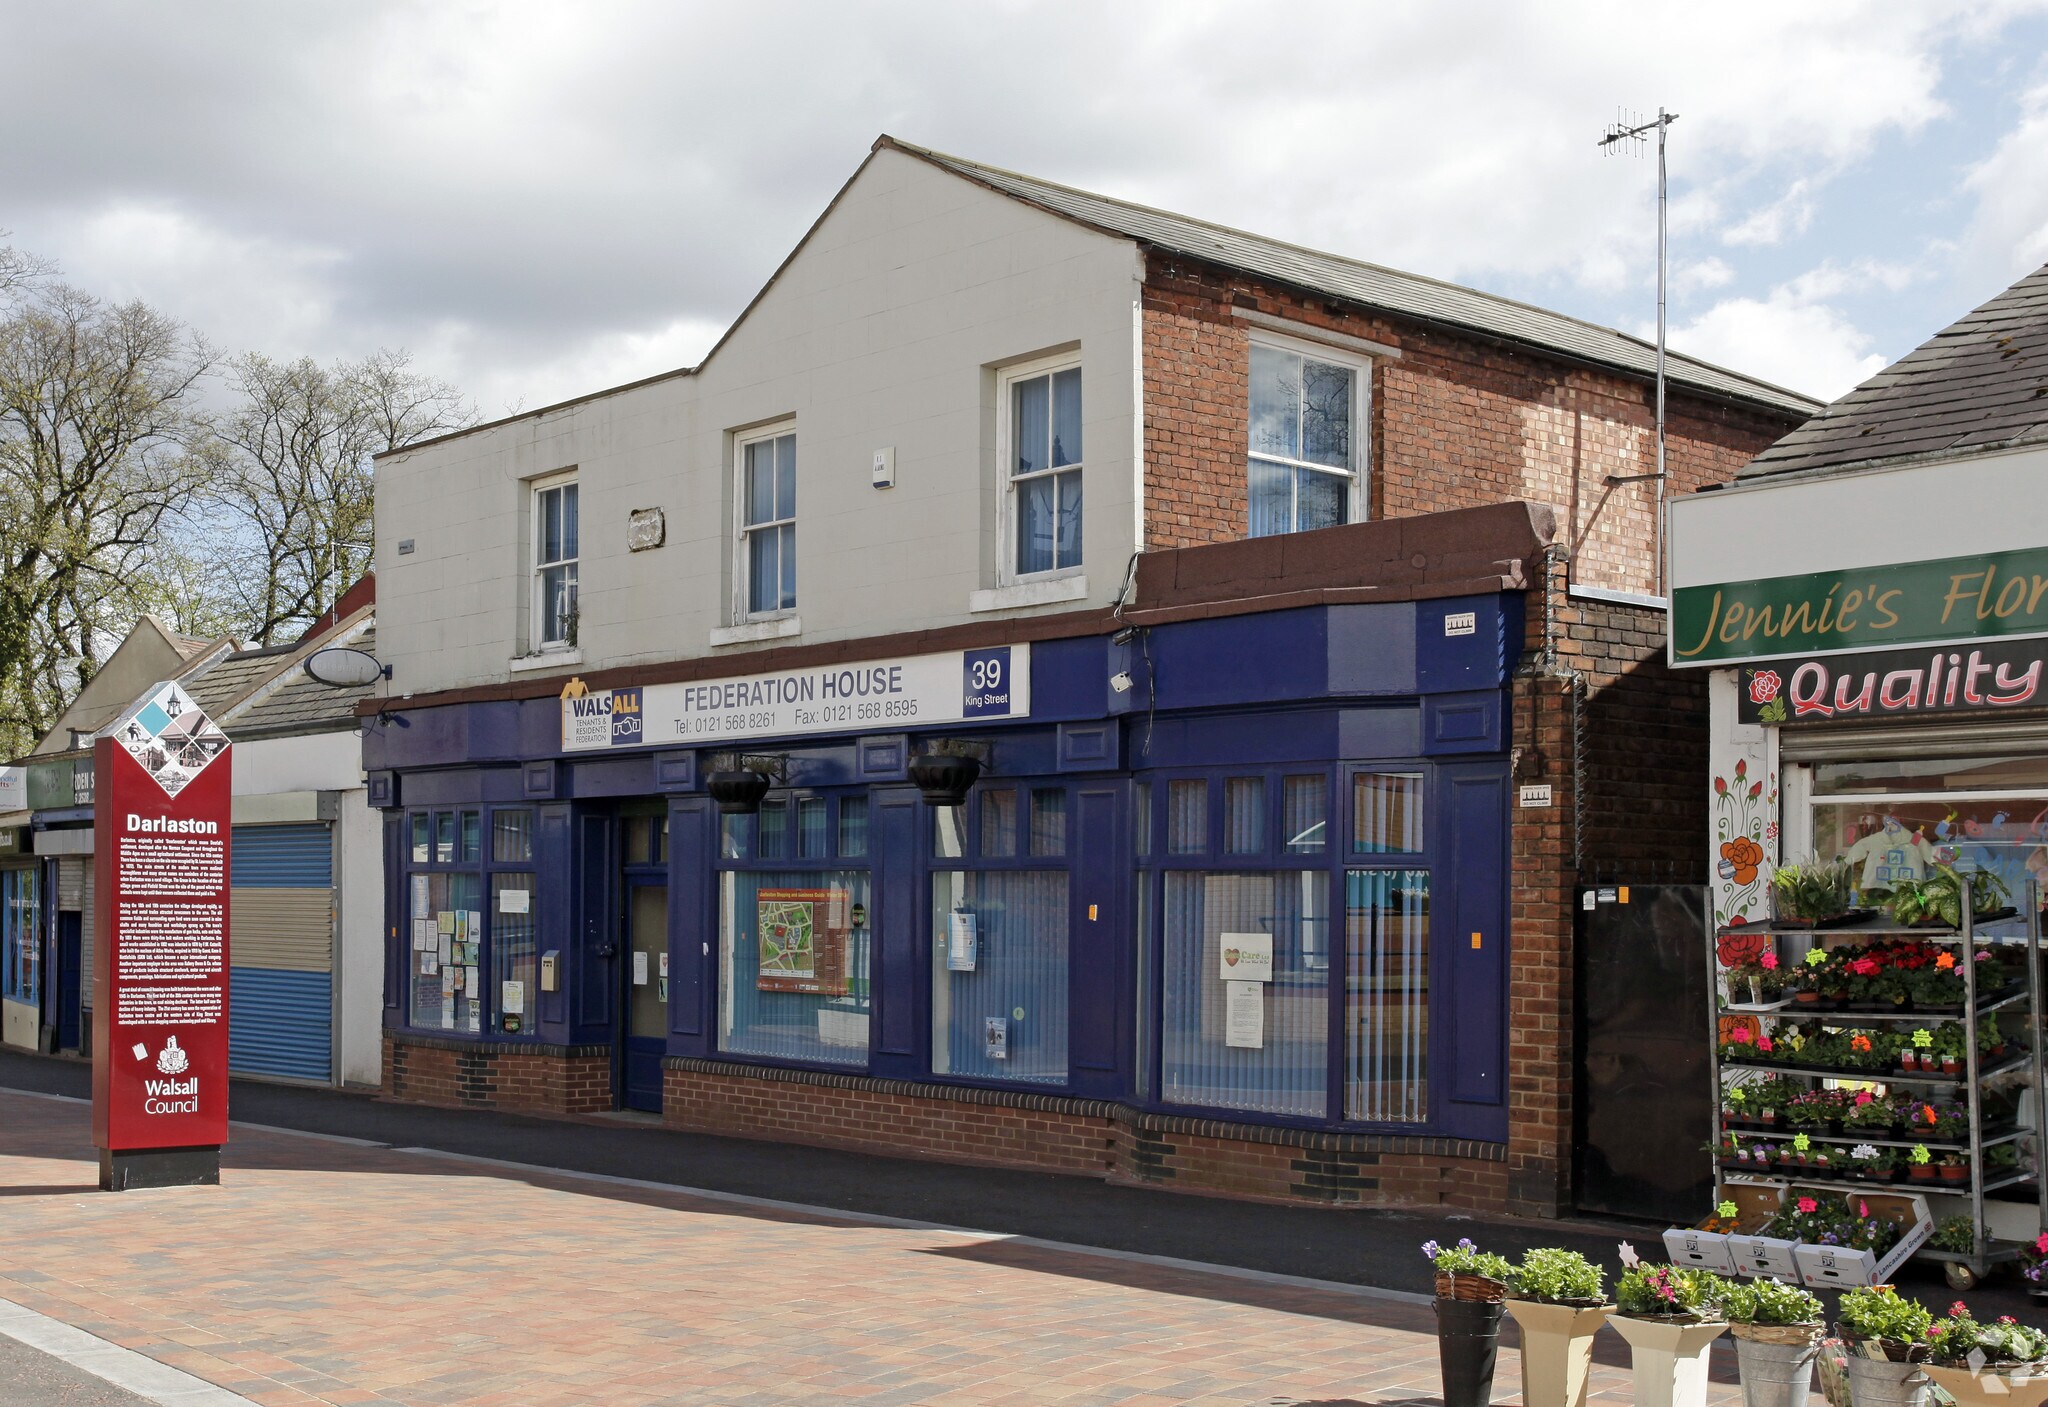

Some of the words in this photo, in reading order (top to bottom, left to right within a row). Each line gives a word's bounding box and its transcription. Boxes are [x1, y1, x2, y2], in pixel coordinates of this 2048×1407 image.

[1676, 582, 1903, 656] Jennie's
[971, 659, 1001, 690] 39
[1789, 650, 2043, 719] Quality
[685, 675, 814, 713] FEDERATION
[822, 666, 902, 699] HOUSE
[965, 693, 981, 709] King
[983, 691, 1008, 706] Street
[573, 694, 639, 717] WALSALL
[795, 709, 819, 725] Fax:
[823, 706, 854, 723] 0121
[857, 702, 880, 720] 568
[885, 699, 918, 718] 8595
[576, 719, 601, 727] TENANTS
[576, 726, 607, 735] RESIDENTS
[674, 719, 692, 734] Tel:
[695, 716, 721, 733] 0121
[725, 714, 746, 731] 568
[748, 712, 776, 729] 8261
[576, 734, 607, 743] FEDERATION
[127, 814, 218, 834] Darlaston
[145, 1077, 198, 1096] Walsall
[145, 1096, 198, 1115] Council
[1878, 1246, 1908, 1276] Lancashire
[1907, 1231, 1925, 1248] Grown
